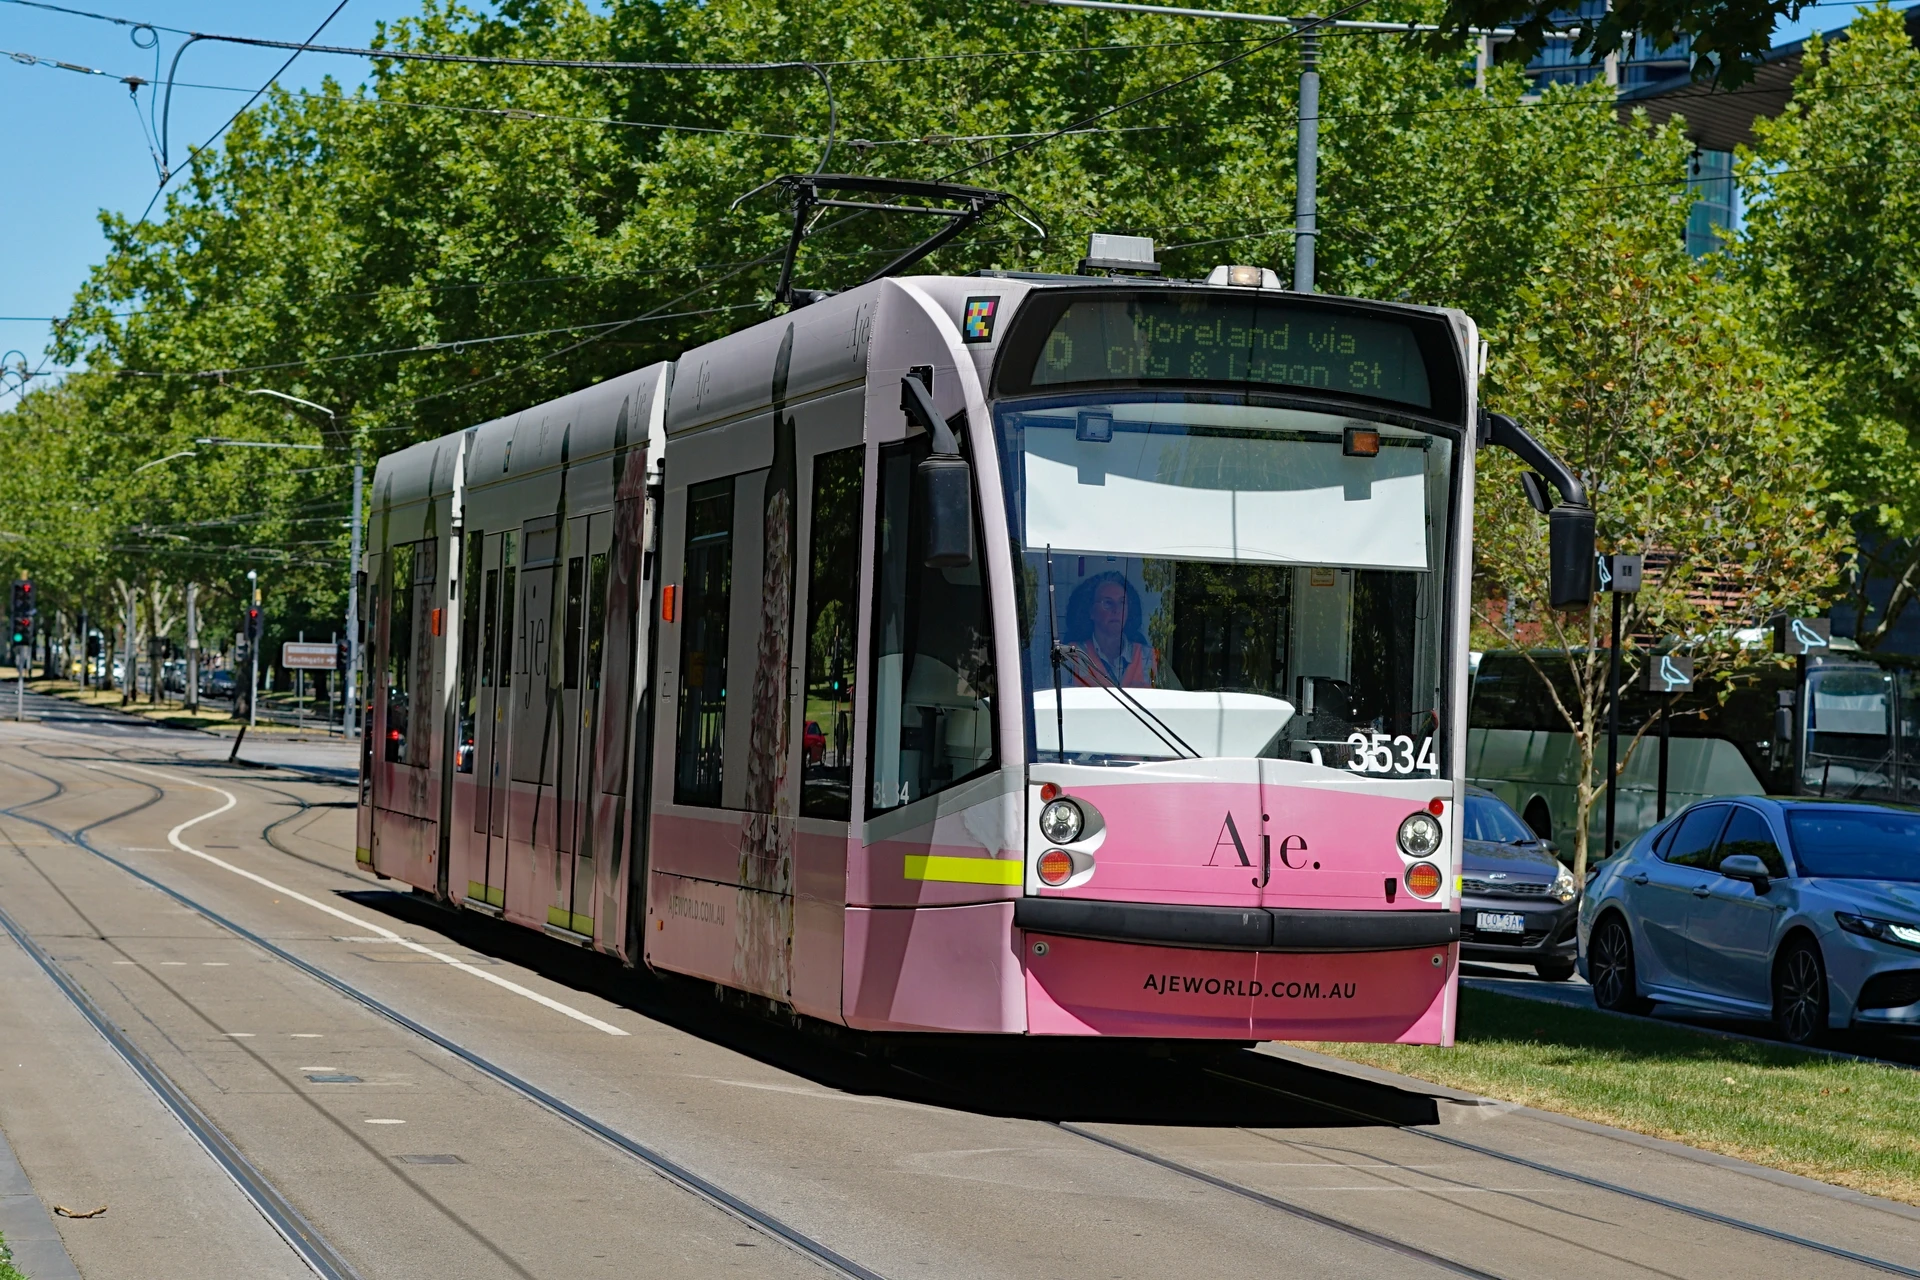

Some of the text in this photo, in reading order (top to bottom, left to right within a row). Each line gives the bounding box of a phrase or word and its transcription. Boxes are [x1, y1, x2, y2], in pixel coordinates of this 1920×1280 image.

[1133, 314, 1356, 354] Moreland via
[1107, 346, 1382, 388] City & Lygon St
[1347, 733, 1438, 775] 3534
[1202, 811, 1321, 888] Aje.
[1143, 973, 1357, 999] AJEWORLD.COM.AU
